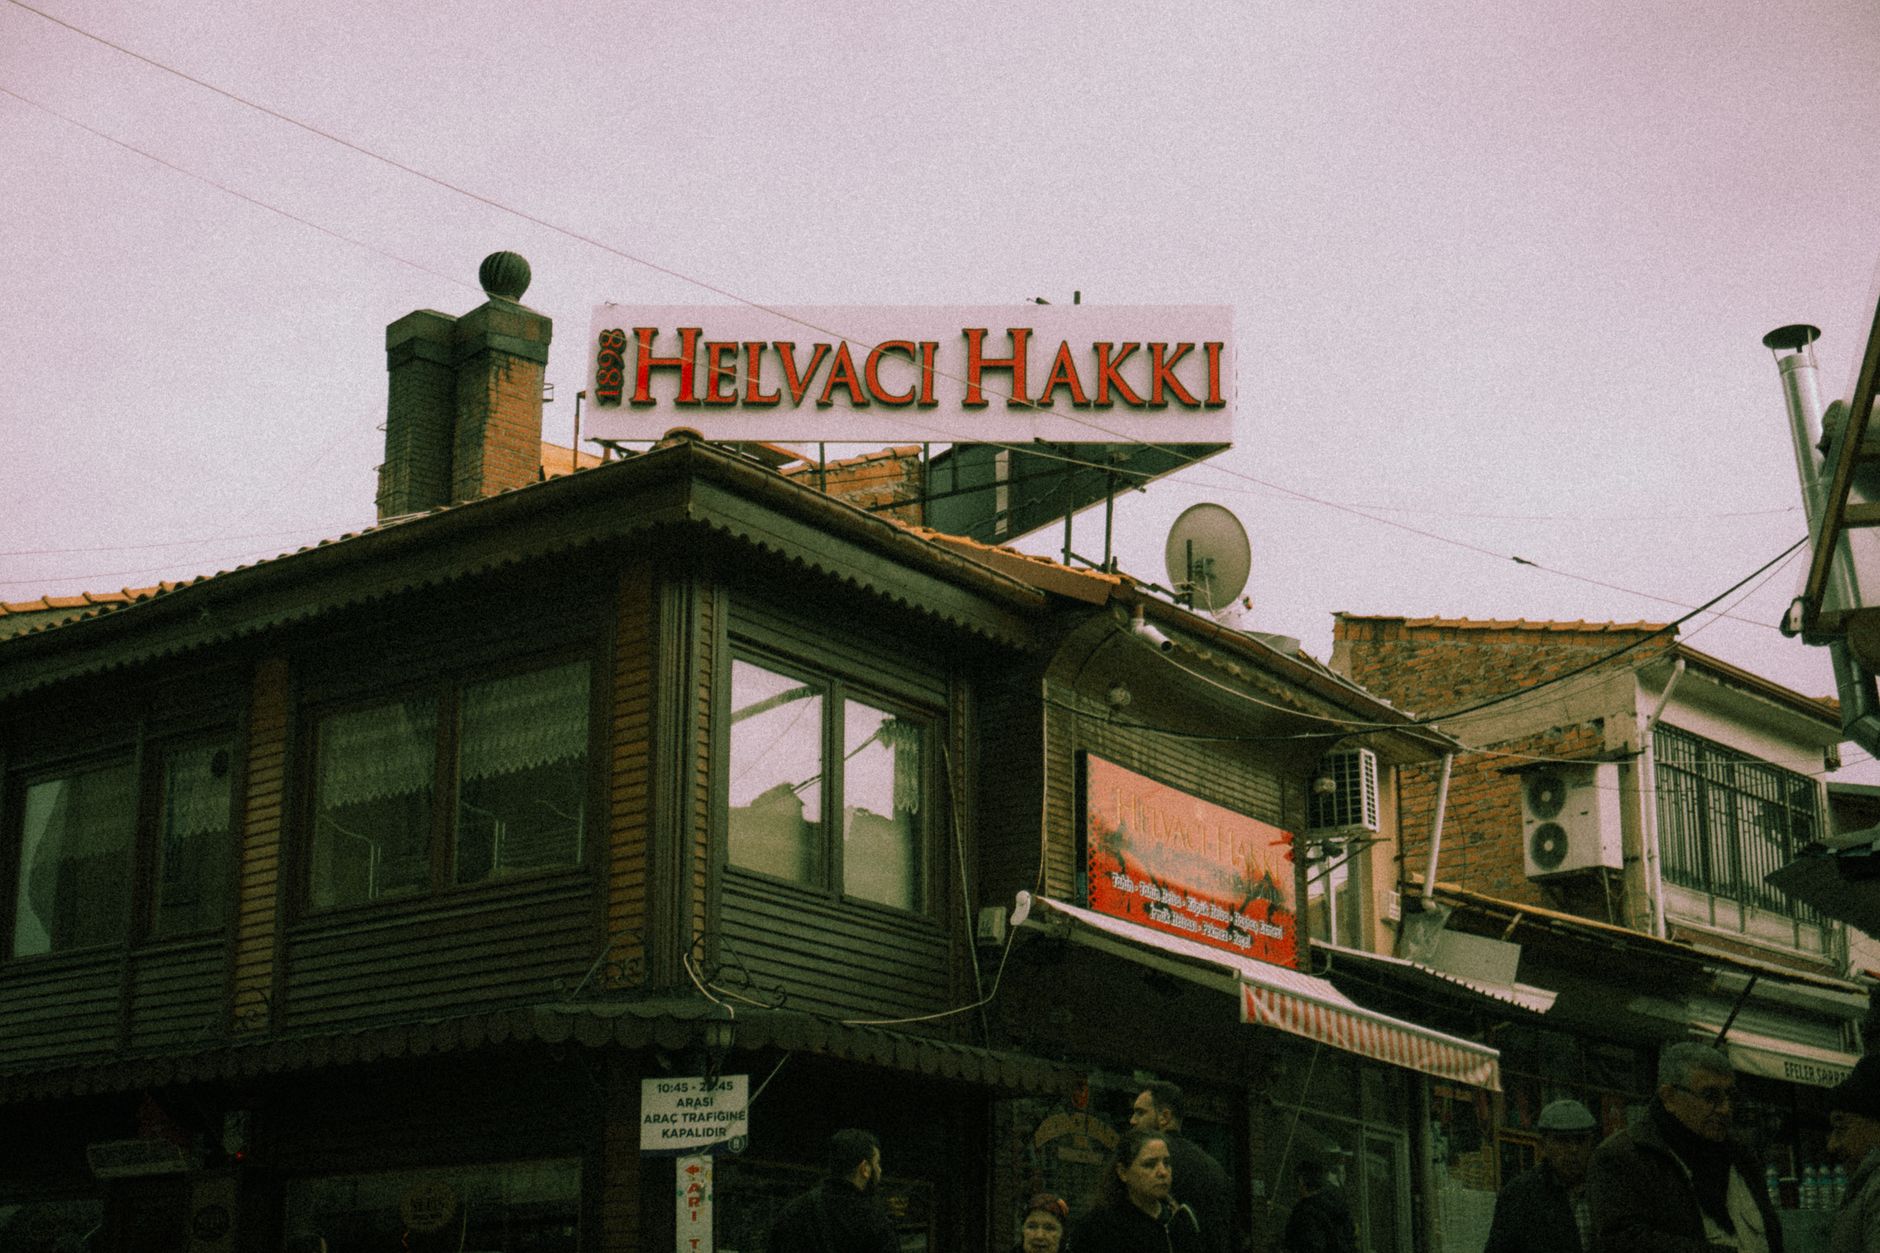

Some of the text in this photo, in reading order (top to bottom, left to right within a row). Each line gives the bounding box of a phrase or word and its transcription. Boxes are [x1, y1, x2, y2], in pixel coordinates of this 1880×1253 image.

[596, 328, 626, 406] 1898
[630, 328, 1226, 407] HELVACI HAKKI
[1784, 1061, 1816, 1082] EFELER
[657, 1083, 689, 1094] 10:45
[699, 1081, 733, 1093] 2:45
[676, 1097, 714, 1108] ARASI
[644, 1113, 679, 1124] ARAÇ
[662, 1127, 727, 1139] KAPALIDIR
